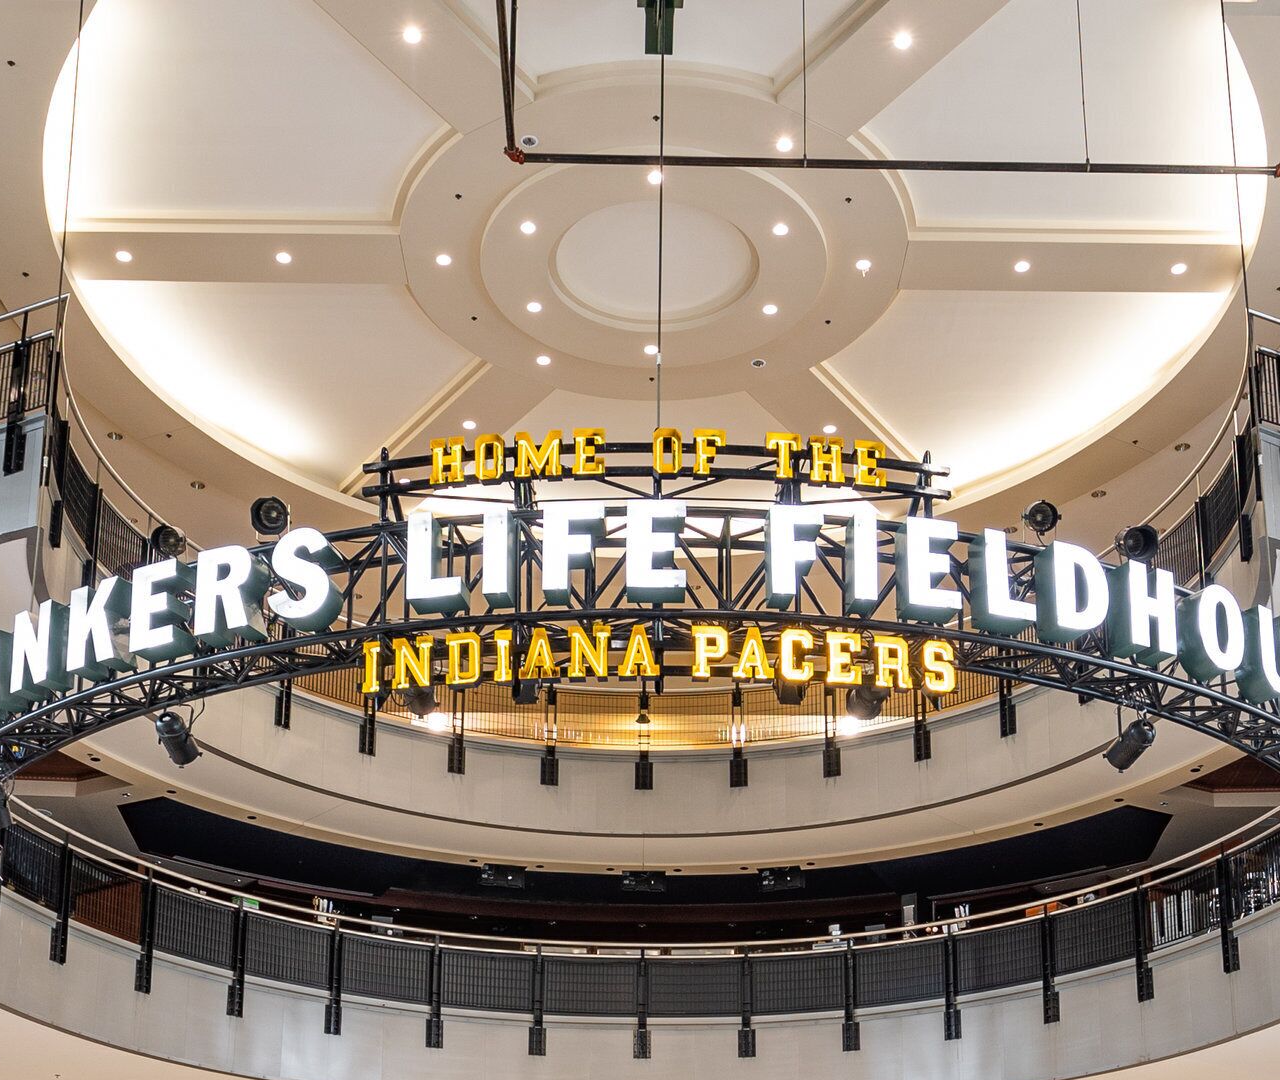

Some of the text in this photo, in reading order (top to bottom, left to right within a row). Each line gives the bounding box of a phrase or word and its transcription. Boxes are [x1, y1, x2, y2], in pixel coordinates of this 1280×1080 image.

[430, 427, 887, 487] HOME OF THE
[406, 501, 686, 603] LIFE
[362, 623, 957, 694] INDIANA PACERS
